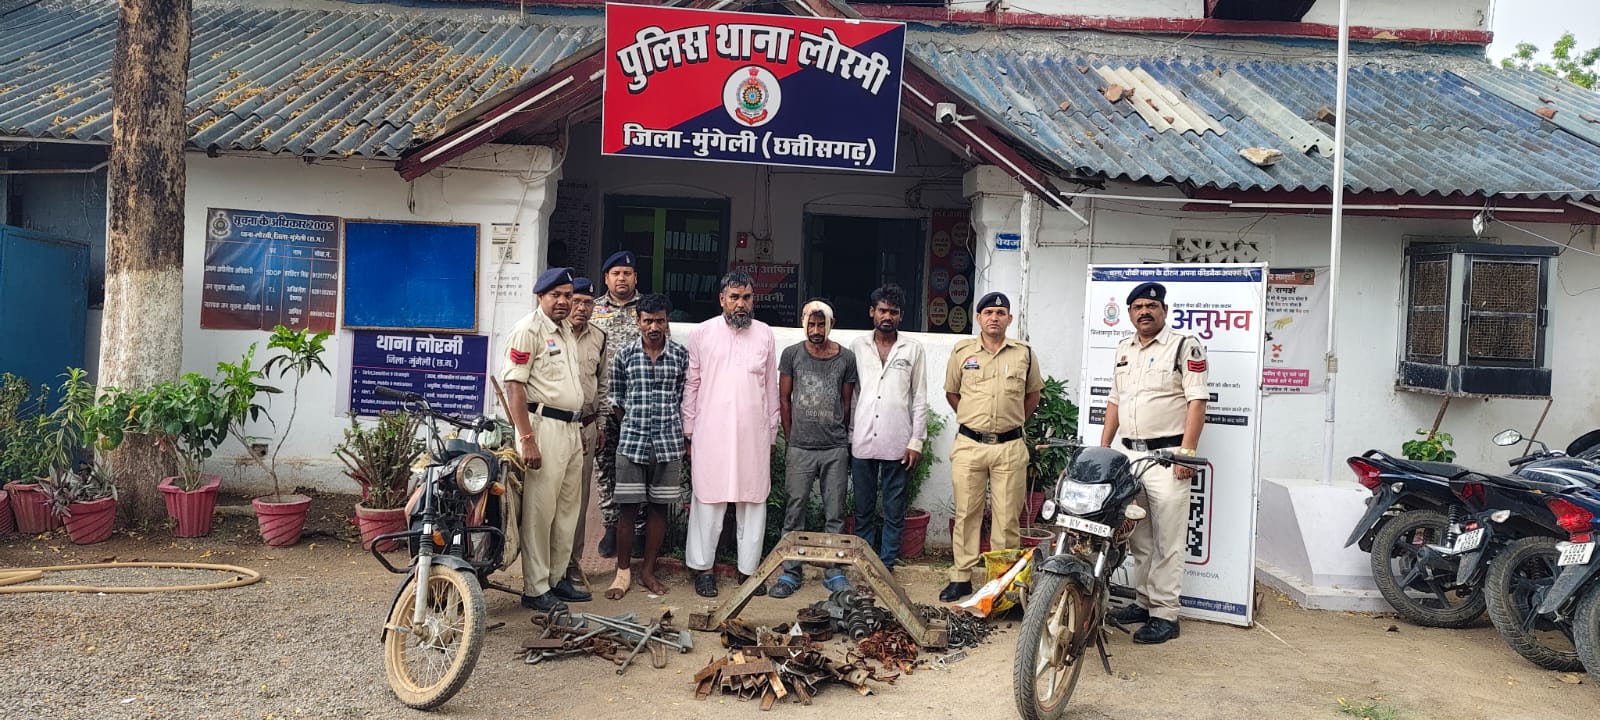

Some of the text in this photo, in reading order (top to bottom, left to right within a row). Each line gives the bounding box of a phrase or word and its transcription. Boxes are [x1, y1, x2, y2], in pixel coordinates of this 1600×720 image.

[616, 23, 891, 95] पुलिस थाना लोरमी
[623, 122, 876, 166] जिला-मुंगेली (छत्तीसगढ़)
[307, 222, 335, 231] 2005
[996, 237, 1020, 247] पेयज
[1171, 309, 1253, 340] अनुभव
[376, 334, 464, 355] थाना लोरमी
[409, 356, 431, 368] मुंगेली
